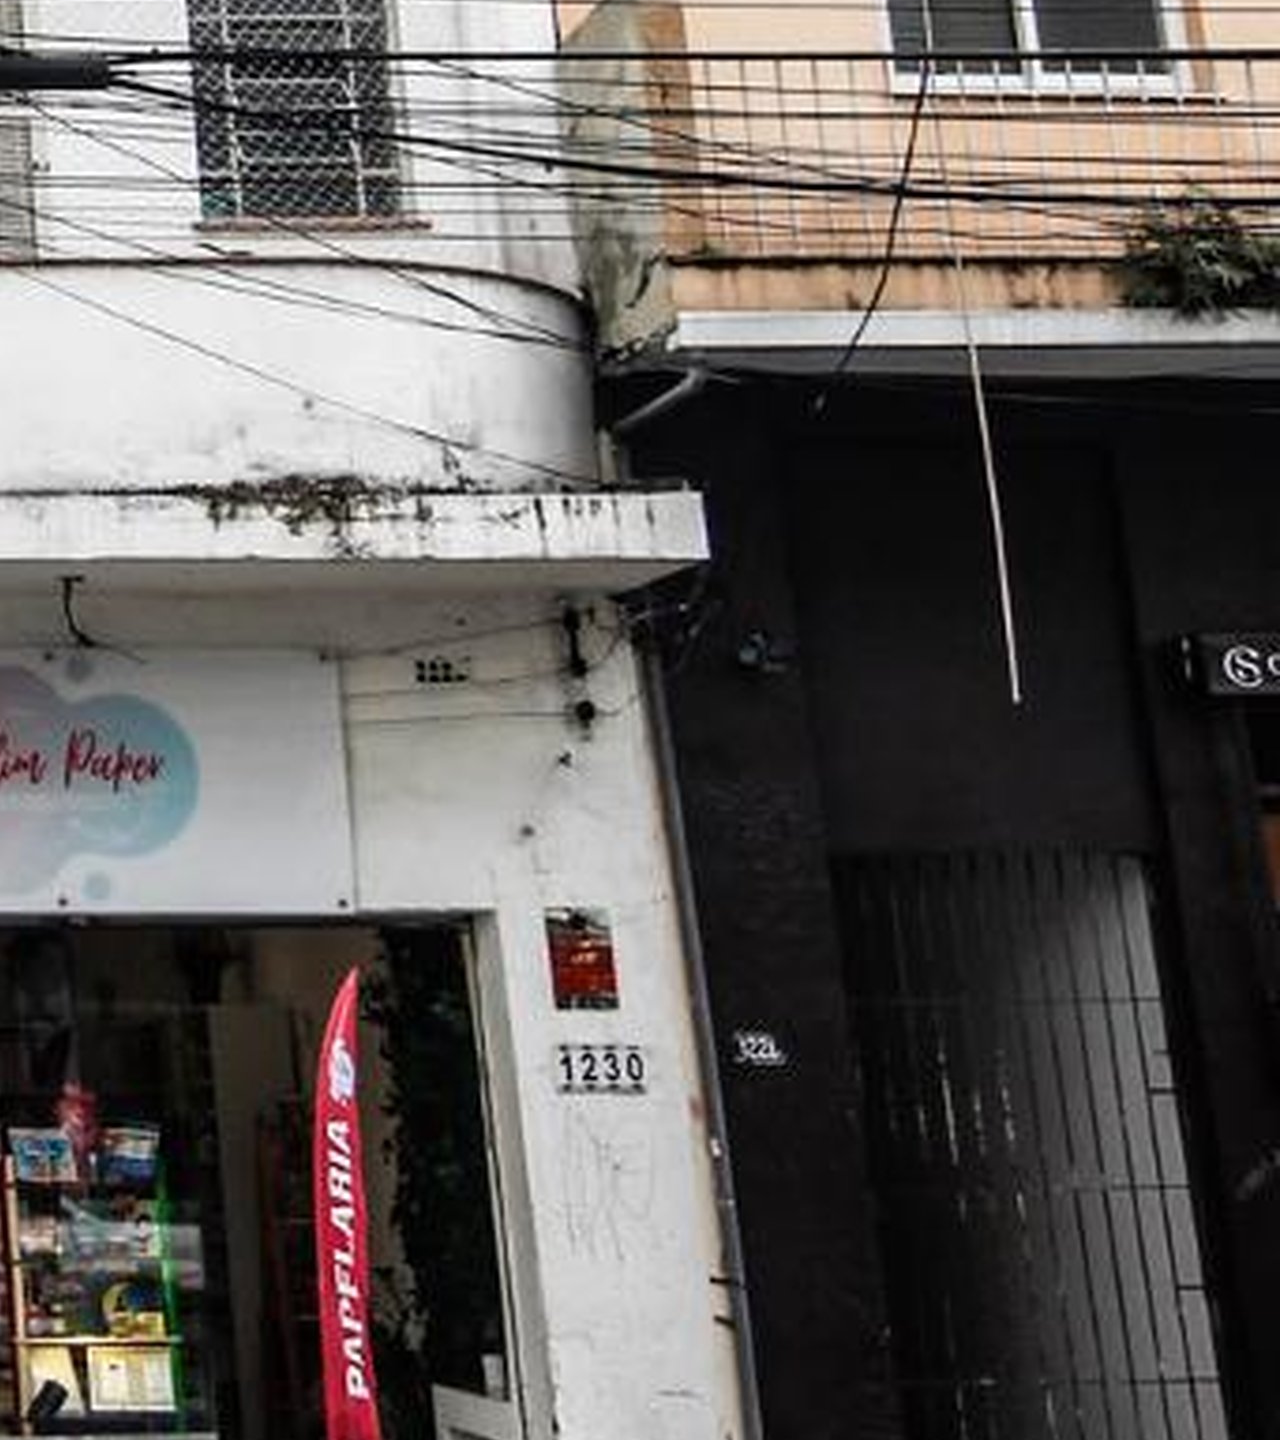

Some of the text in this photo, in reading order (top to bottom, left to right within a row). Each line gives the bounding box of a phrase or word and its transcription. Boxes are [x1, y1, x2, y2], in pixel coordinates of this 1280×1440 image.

[62, 728, 166, 794] Paper
[557, 1051, 645, 1082] 1230
[327, 1120, 370, 1402] PAPELARIA
